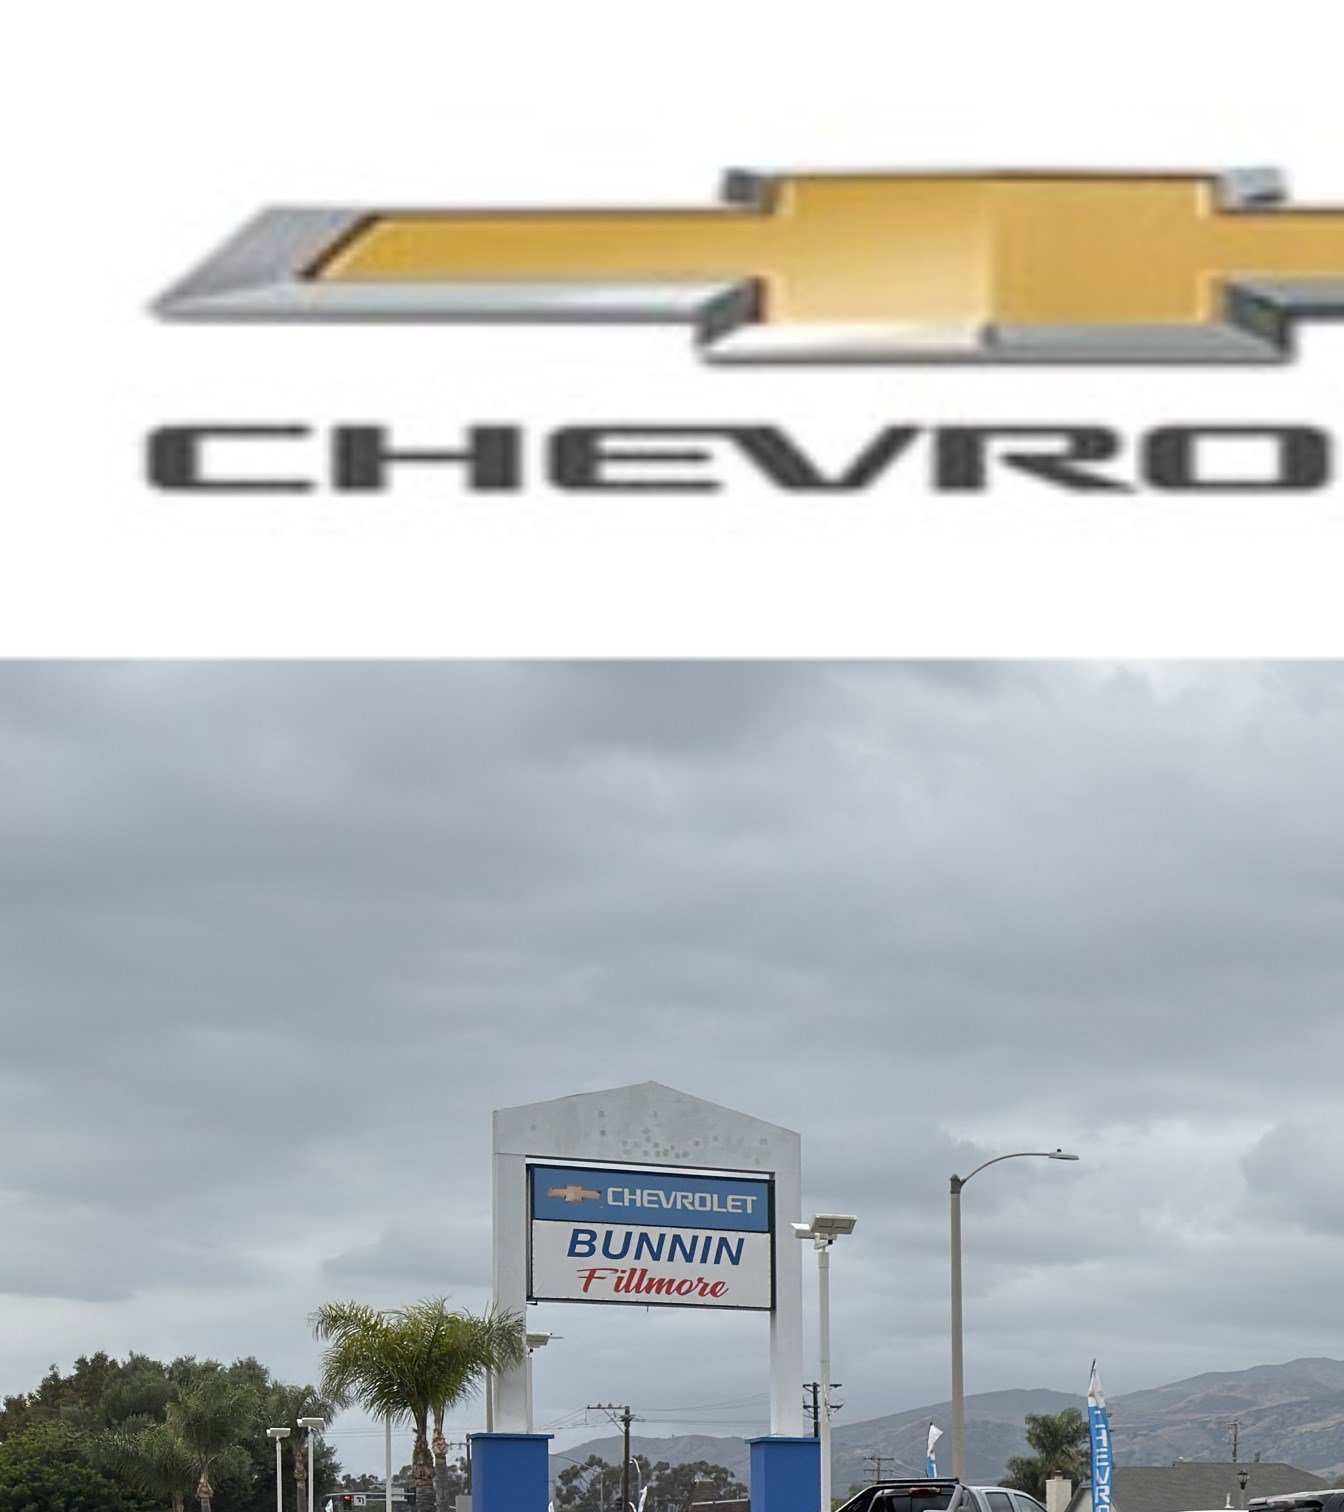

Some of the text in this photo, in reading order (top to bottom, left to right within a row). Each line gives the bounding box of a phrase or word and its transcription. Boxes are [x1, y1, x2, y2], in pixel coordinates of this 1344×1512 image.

[607, 1187, 757, 1214] CHEVROLET
[567, 1228, 745, 1266] BUNNIN
[576, 1267, 730, 1298] Fillmore
